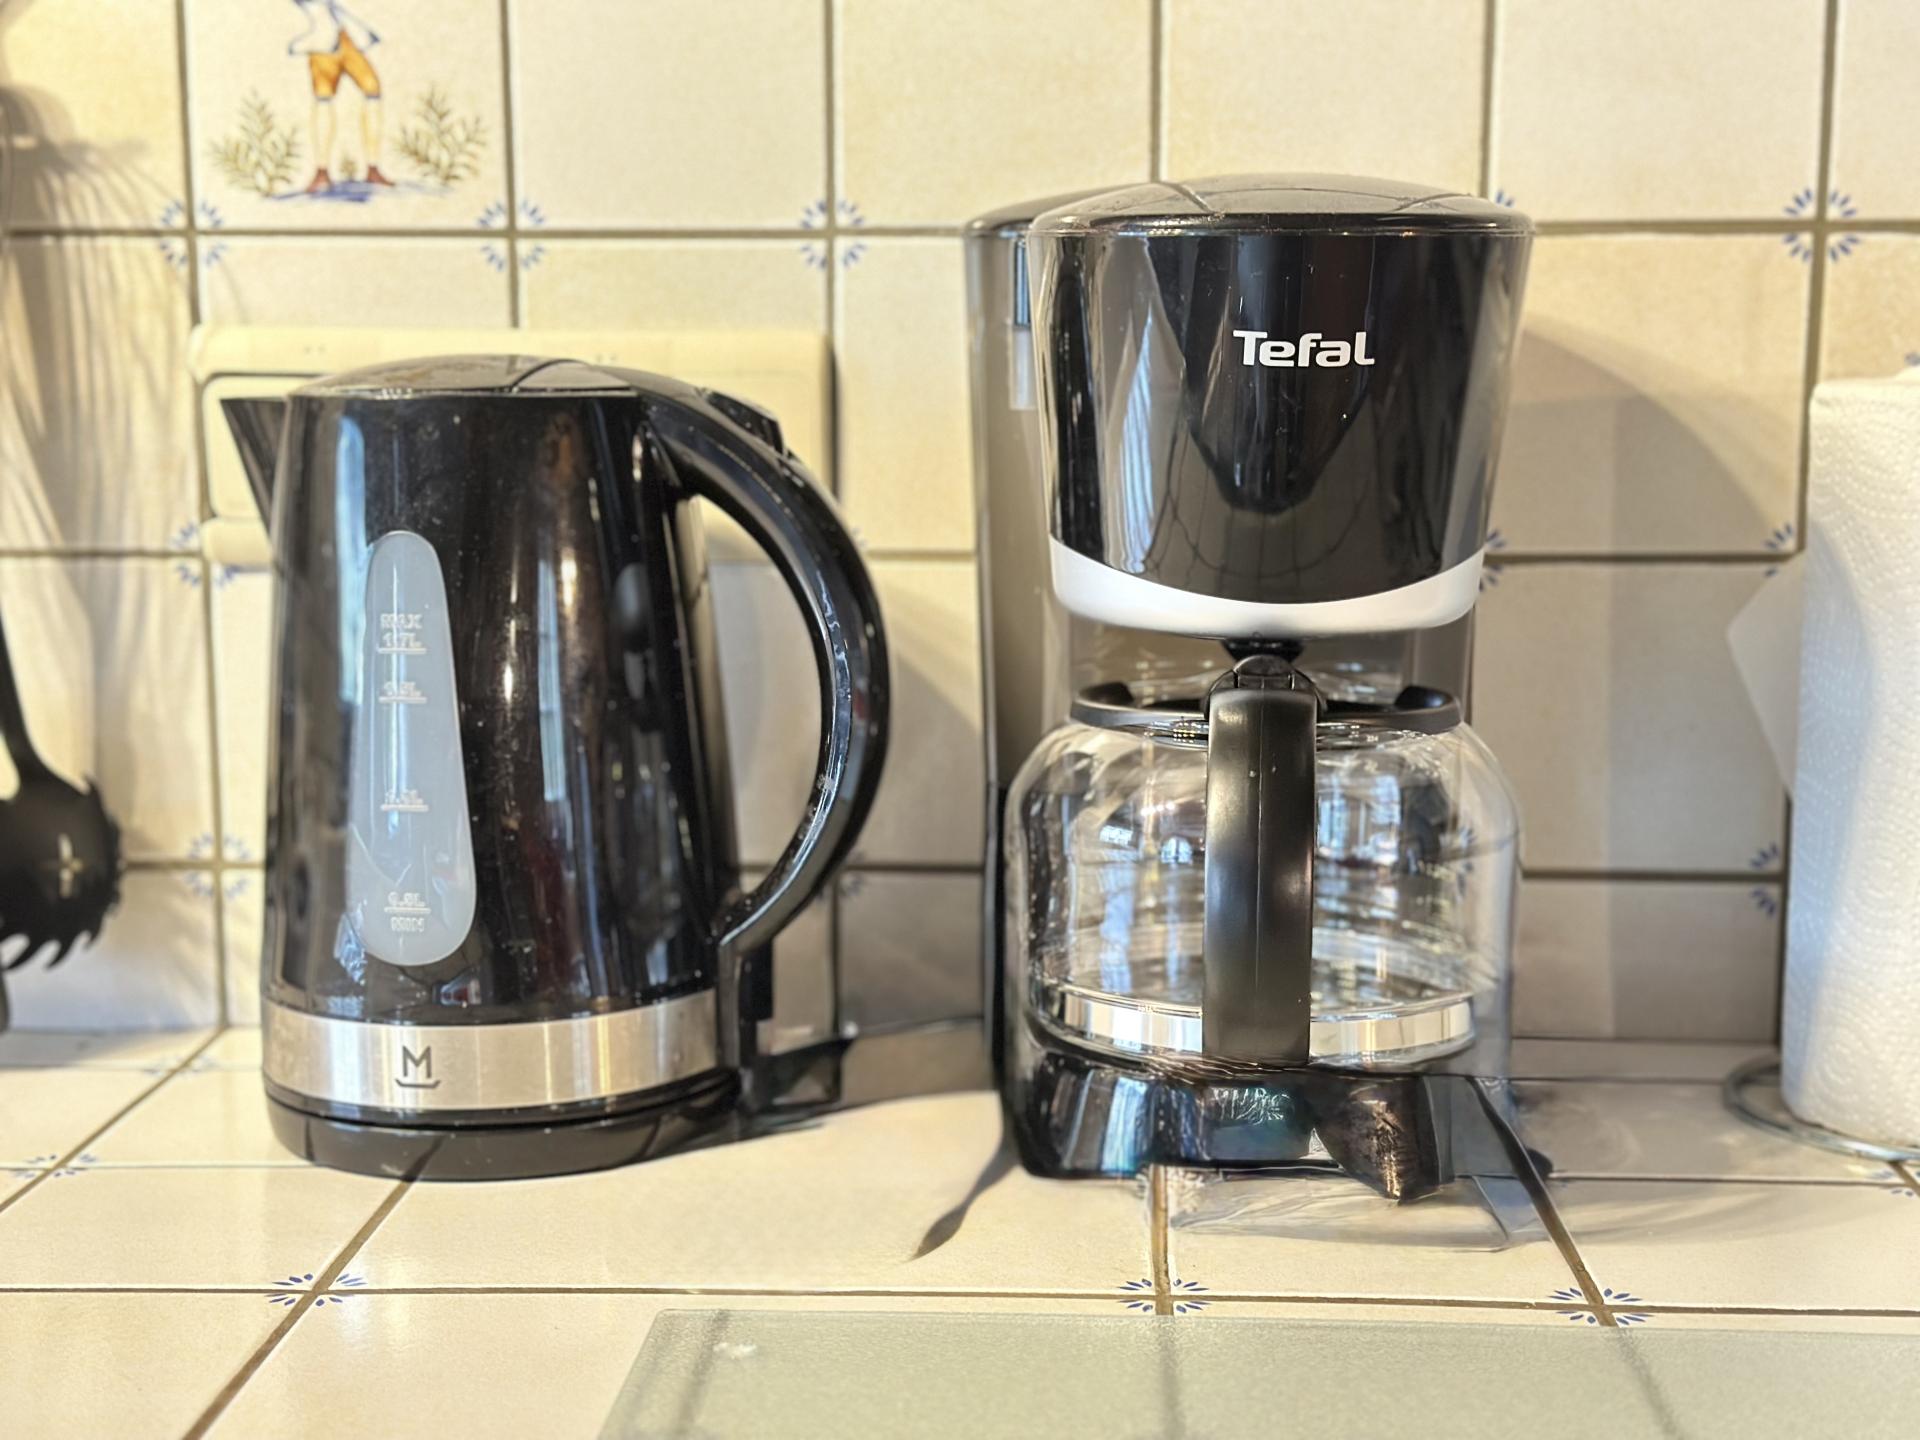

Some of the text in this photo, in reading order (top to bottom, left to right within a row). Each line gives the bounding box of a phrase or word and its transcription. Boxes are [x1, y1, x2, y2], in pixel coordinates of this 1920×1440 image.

[1233, 330, 1375, 367] Tefal
[382, 632, 422, 648] 17L
[402, 1045, 432, 1079] M
